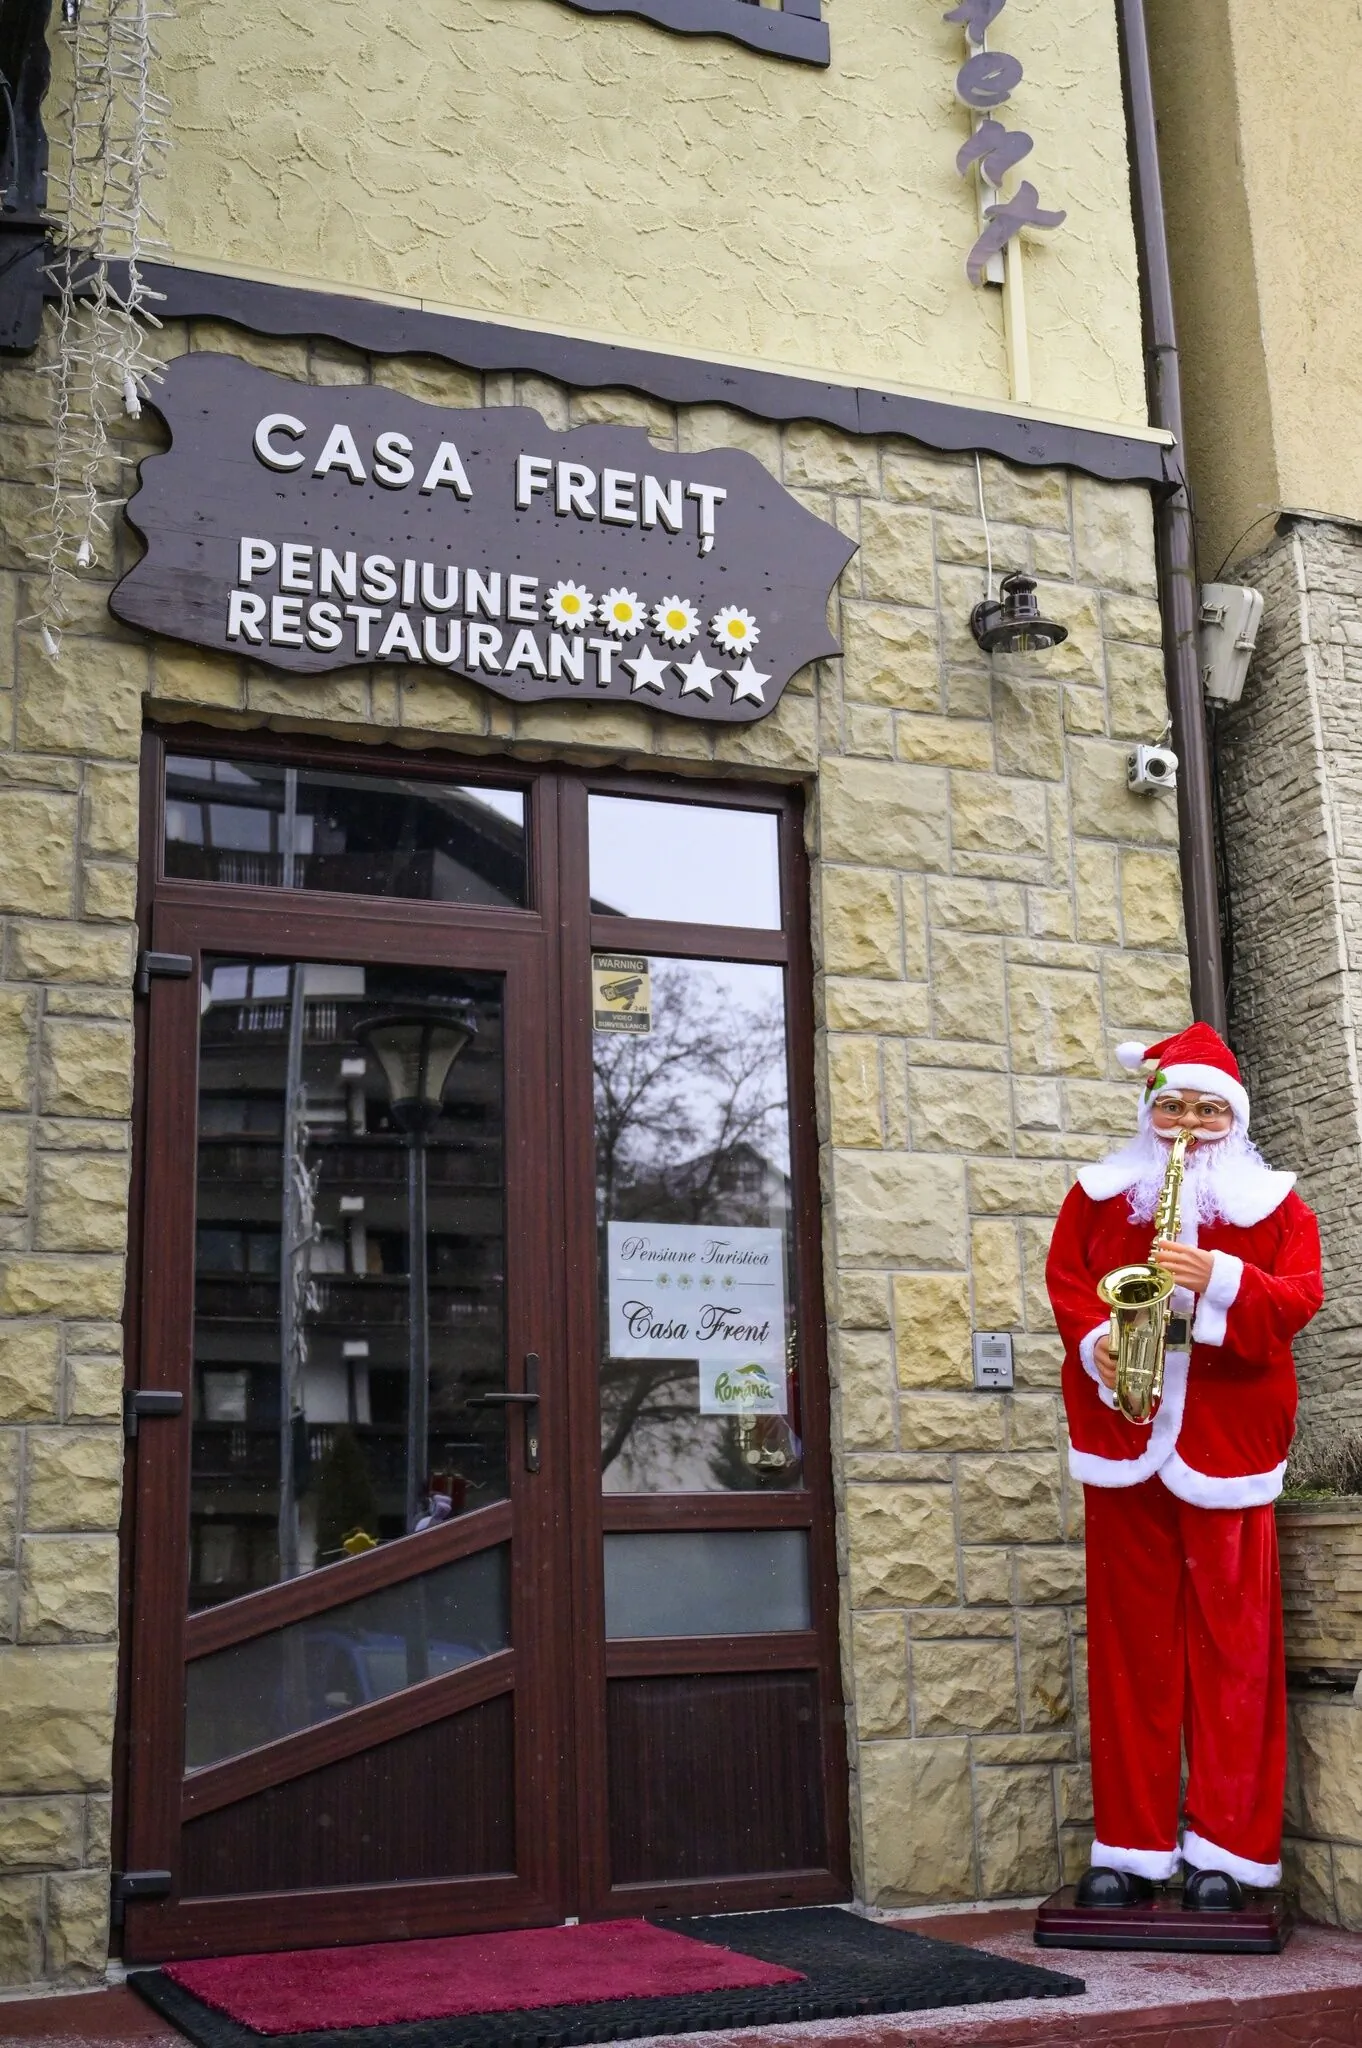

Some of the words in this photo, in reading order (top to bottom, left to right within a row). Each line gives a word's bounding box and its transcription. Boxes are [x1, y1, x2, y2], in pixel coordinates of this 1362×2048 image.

[253, 412, 473, 500] CASA
[237, 536, 540, 626] PENSIUNE
[226, 589, 623, 686] RESTAURANT
[599, 957, 644, 970] WARNING
[598, 1020, 648, 1030] SURVEILLANCE
[620, 1236, 697, 1263] Pensiune
[621, 1300, 690, 1340] Casa
